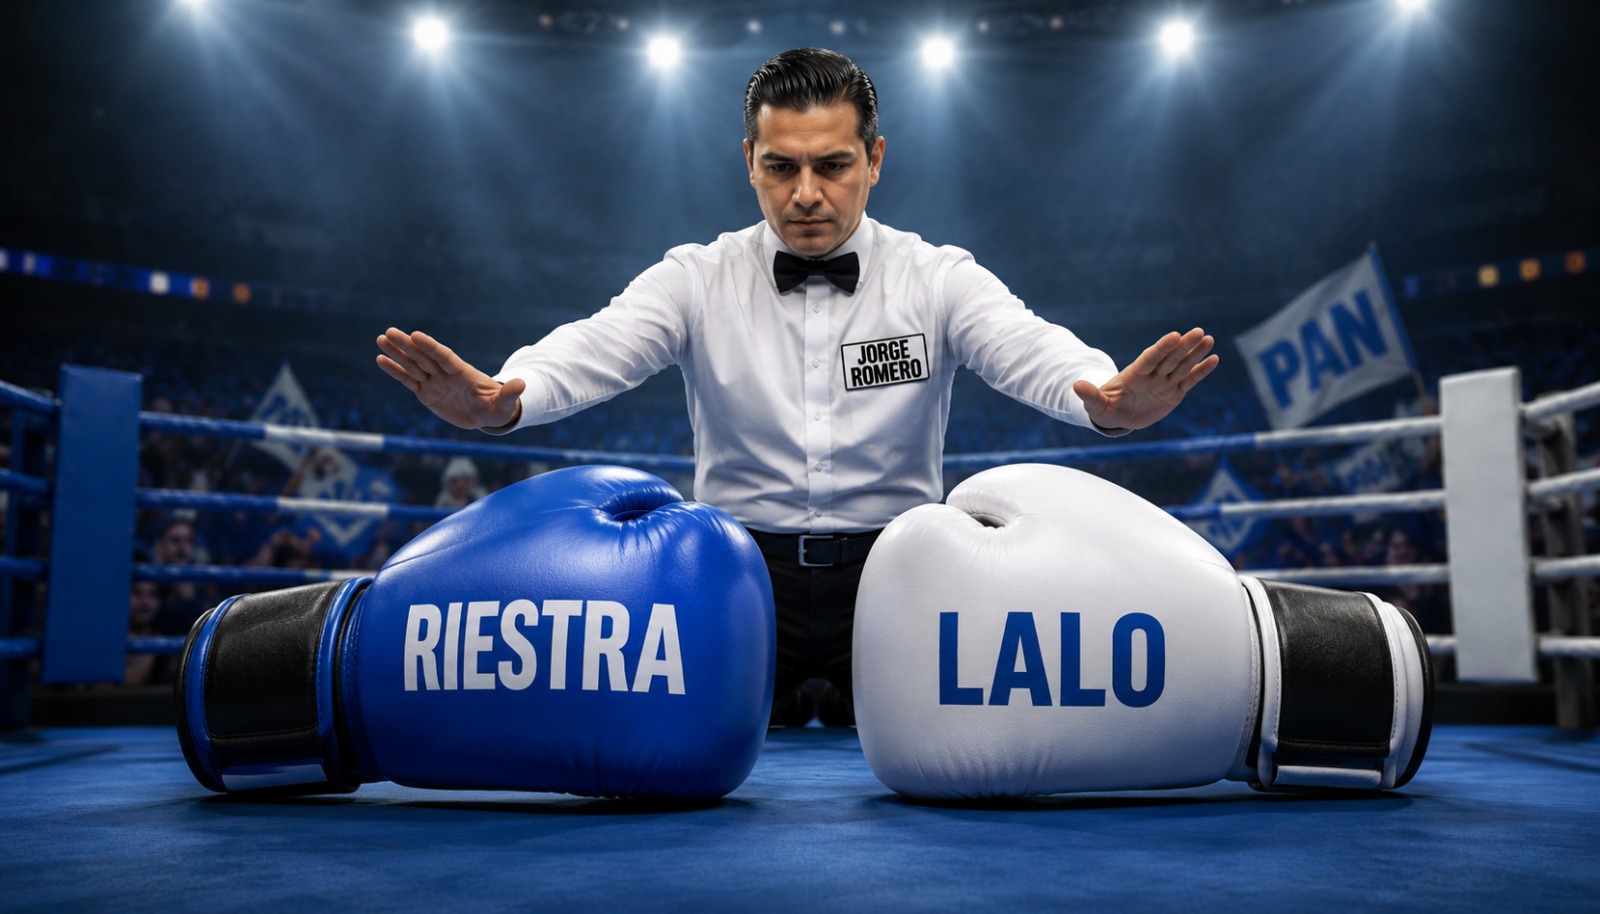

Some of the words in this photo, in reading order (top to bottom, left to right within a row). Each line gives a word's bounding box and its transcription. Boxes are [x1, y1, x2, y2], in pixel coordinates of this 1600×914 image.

[850, 358, 922, 387] ROMERO
[858, 339, 910, 365] JORGE
[1257, 288, 1389, 410] PAN
[404, 598, 686, 695] RIESTRA
[938, 611, 1166, 708] LALO
